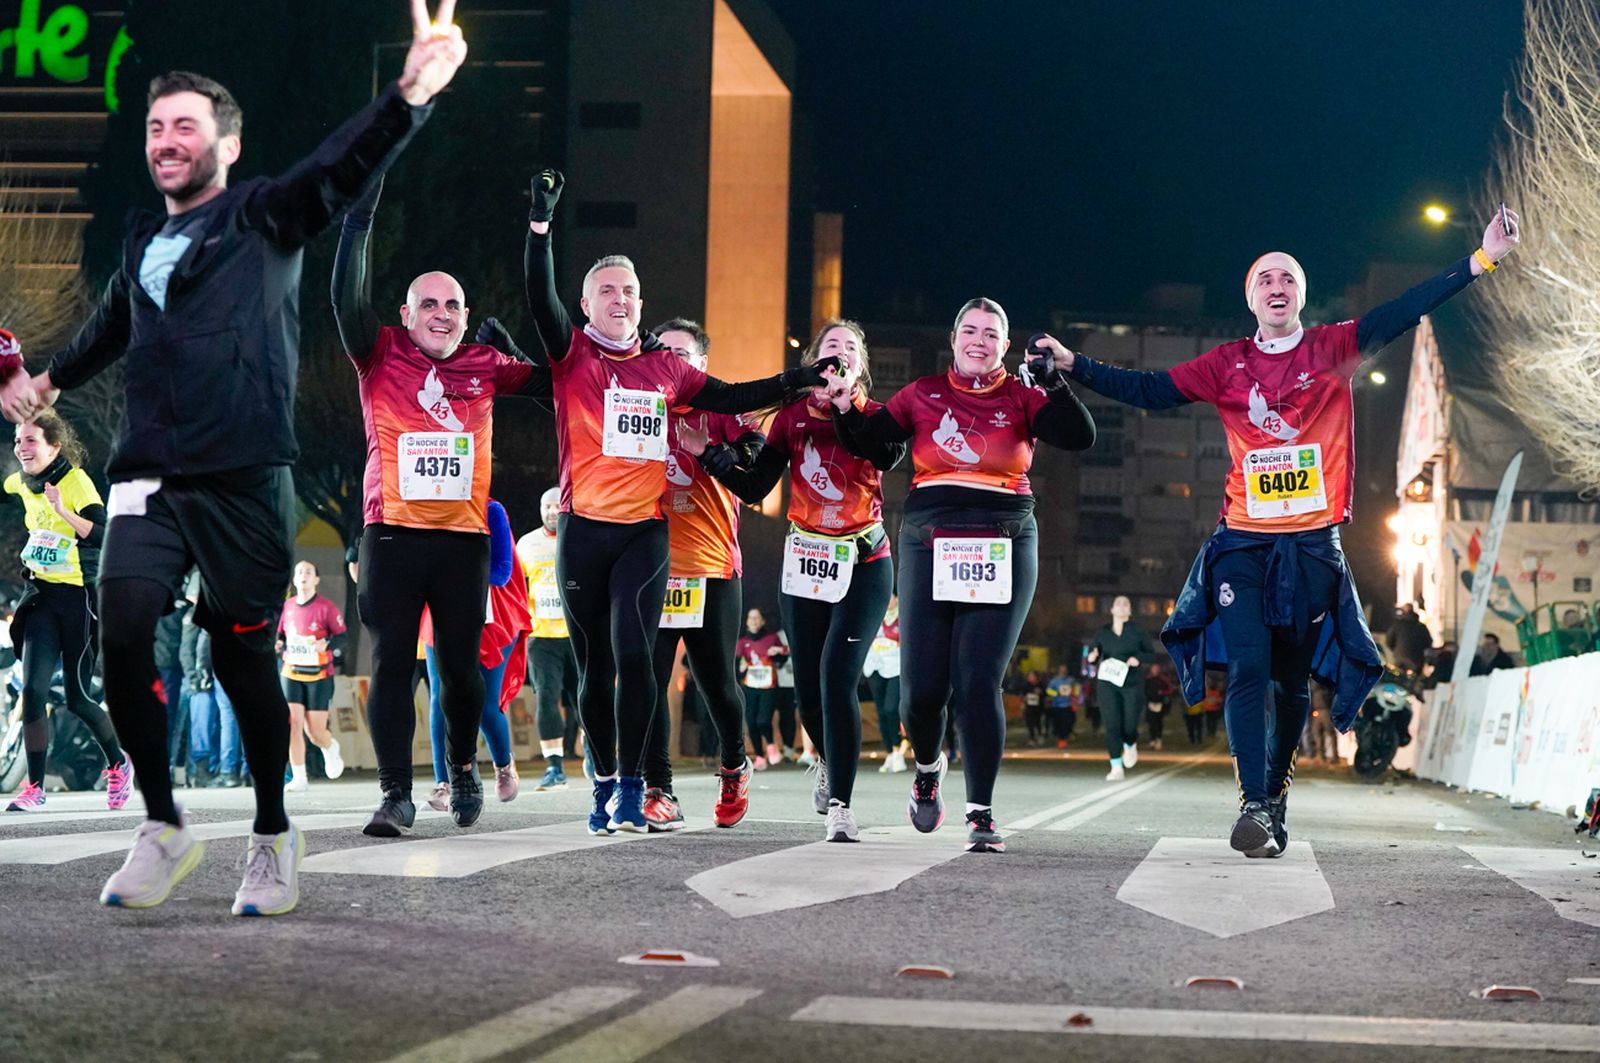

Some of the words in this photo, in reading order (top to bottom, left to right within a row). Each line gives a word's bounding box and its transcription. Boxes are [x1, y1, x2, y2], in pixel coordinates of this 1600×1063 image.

[613, 404, 628, 412] SAN
[622, 397, 643, 405] NOCHE
[430, 402, 450, 420] 43
[618, 414, 661, 437] 6998
[1263, 417, 1280, 433] 43
[943, 437, 964, 452] 43
[415, 457, 460, 477] 4375
[1252, 465, 1266, 473] SAN
[811, 472, 828, 490] 43
[1259, 470, 1309, 494] 6402
[792, 547, 805, 555] SAN
[801, 541, 820, 550] NOCHE
[943, 553, 957, 561] SAN
[799, 557, 839, 581] 1694
[950, 562, 996, 582] 1693
[664, 589, 692, 607] 401
